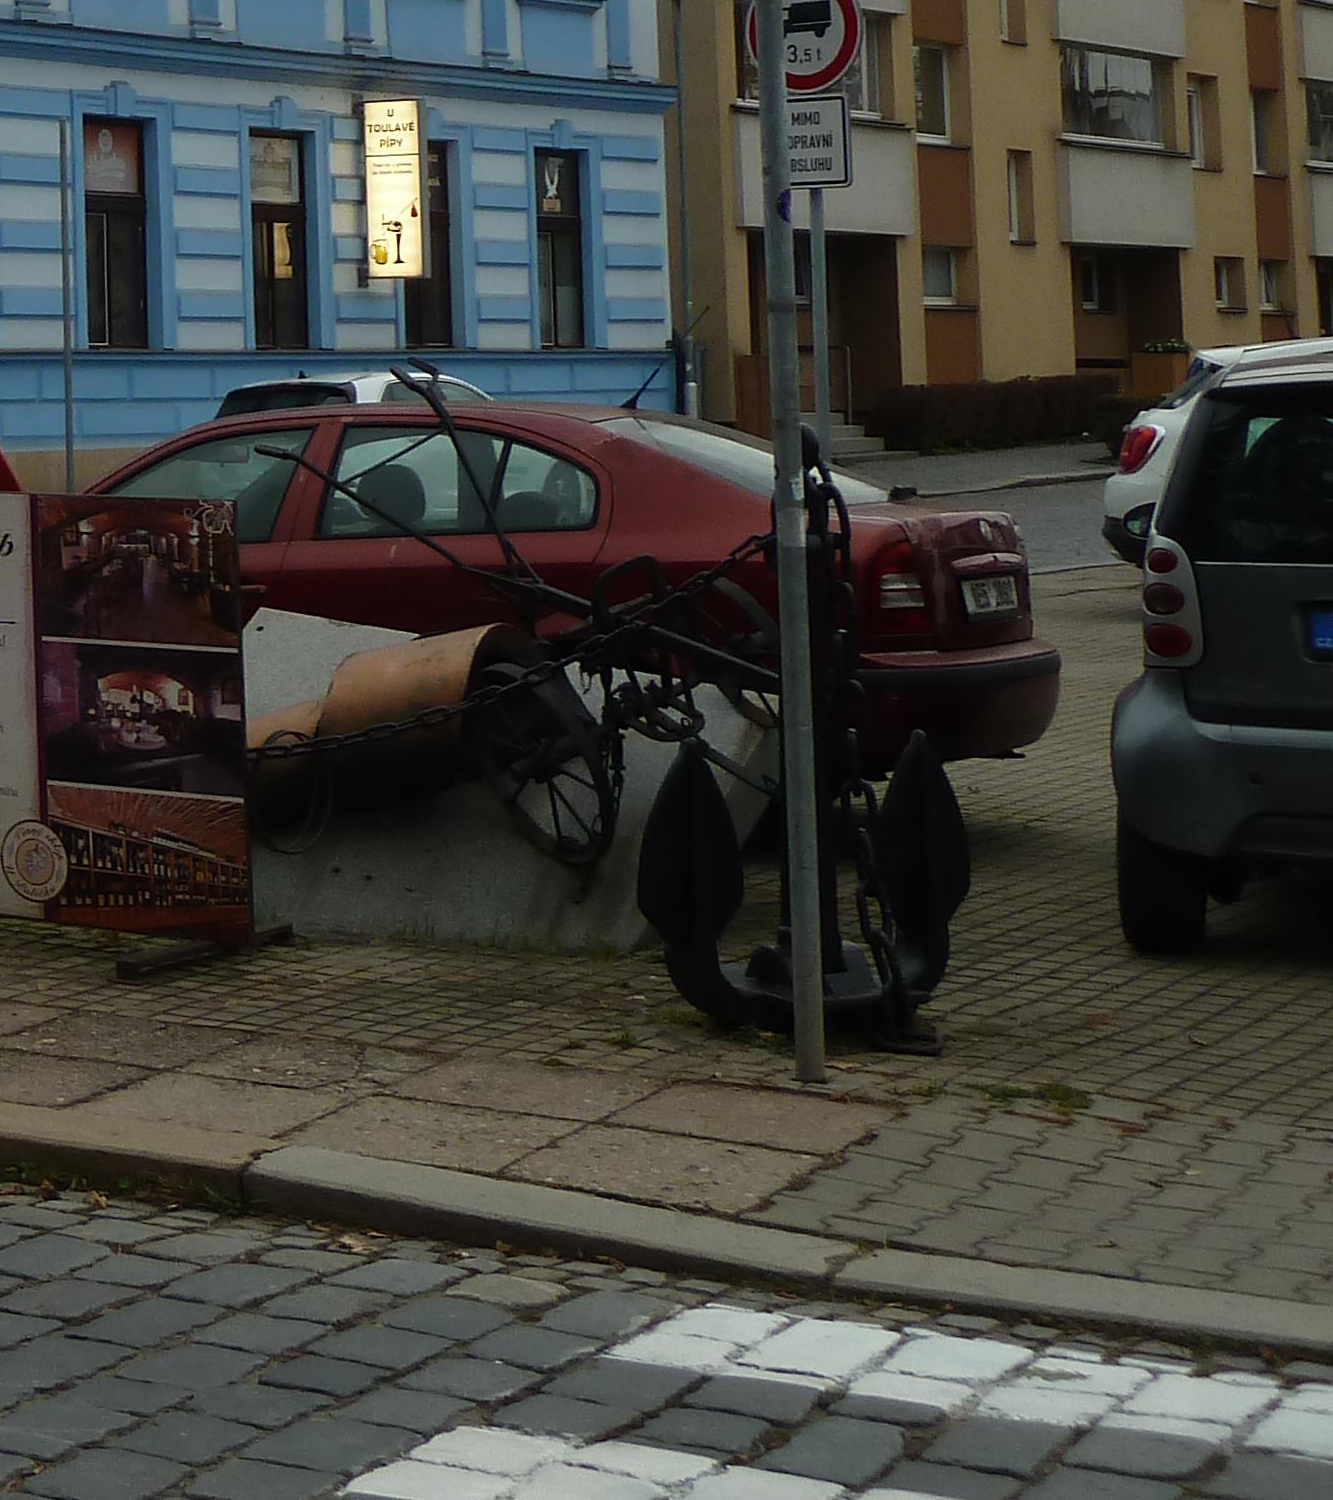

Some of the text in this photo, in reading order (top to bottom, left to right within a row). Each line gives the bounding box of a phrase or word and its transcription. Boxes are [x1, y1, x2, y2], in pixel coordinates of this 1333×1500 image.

[786, 45, 812, 64] 3,5
[386, 108, 395, 117] U
[790, 110, 821, 126] MIMO
[366, 120, 415, 134] TOULAVÉ
[379, 136, 404, 148] PÍPY
[788, 130, 834, 150] OPRAVNÍ
[790, 156, 833, 172] BSLUHU
